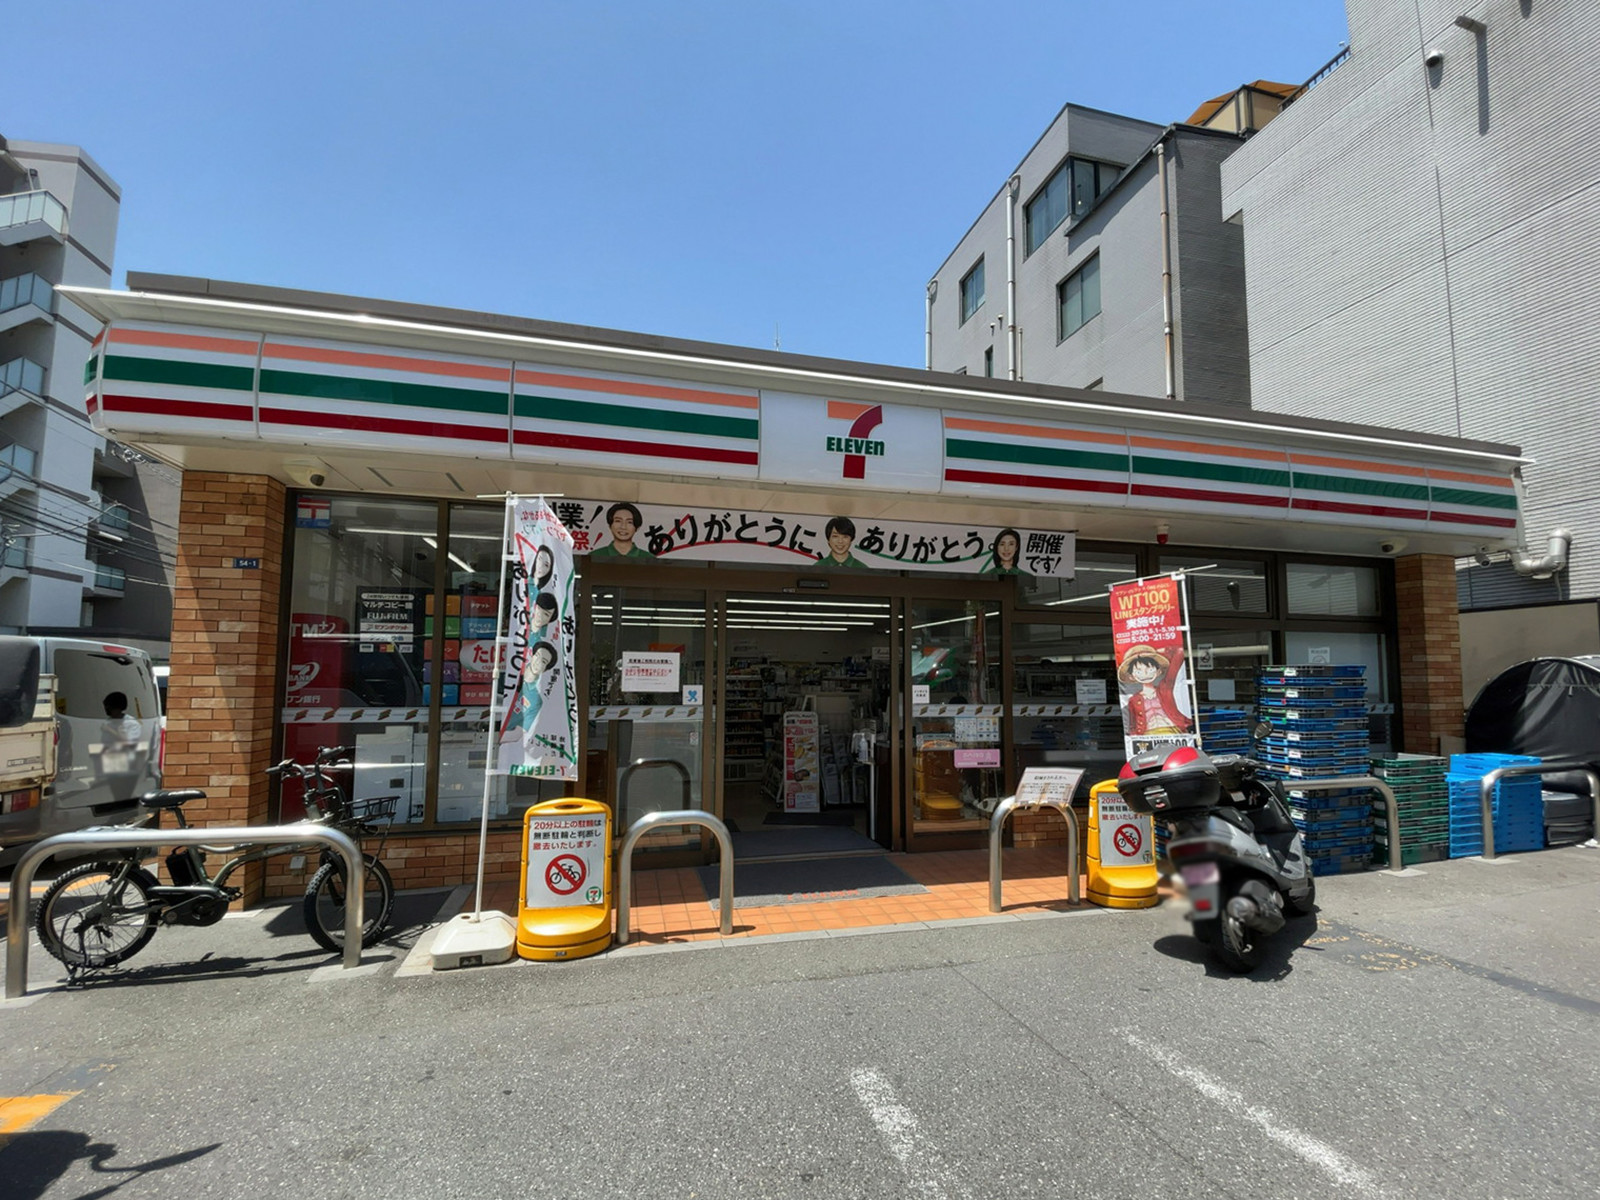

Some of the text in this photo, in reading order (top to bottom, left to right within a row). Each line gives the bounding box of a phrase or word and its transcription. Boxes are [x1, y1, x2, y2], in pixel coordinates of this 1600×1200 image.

[549, 501, 603, 530] 業!
[1026, 533, 1065, 554] 開催
[1025, 555, 1061, 574] です!
[1118, 589, 1170, 610] WT100
[1114, 604, 1176, 620] LINEスタンプラリー
